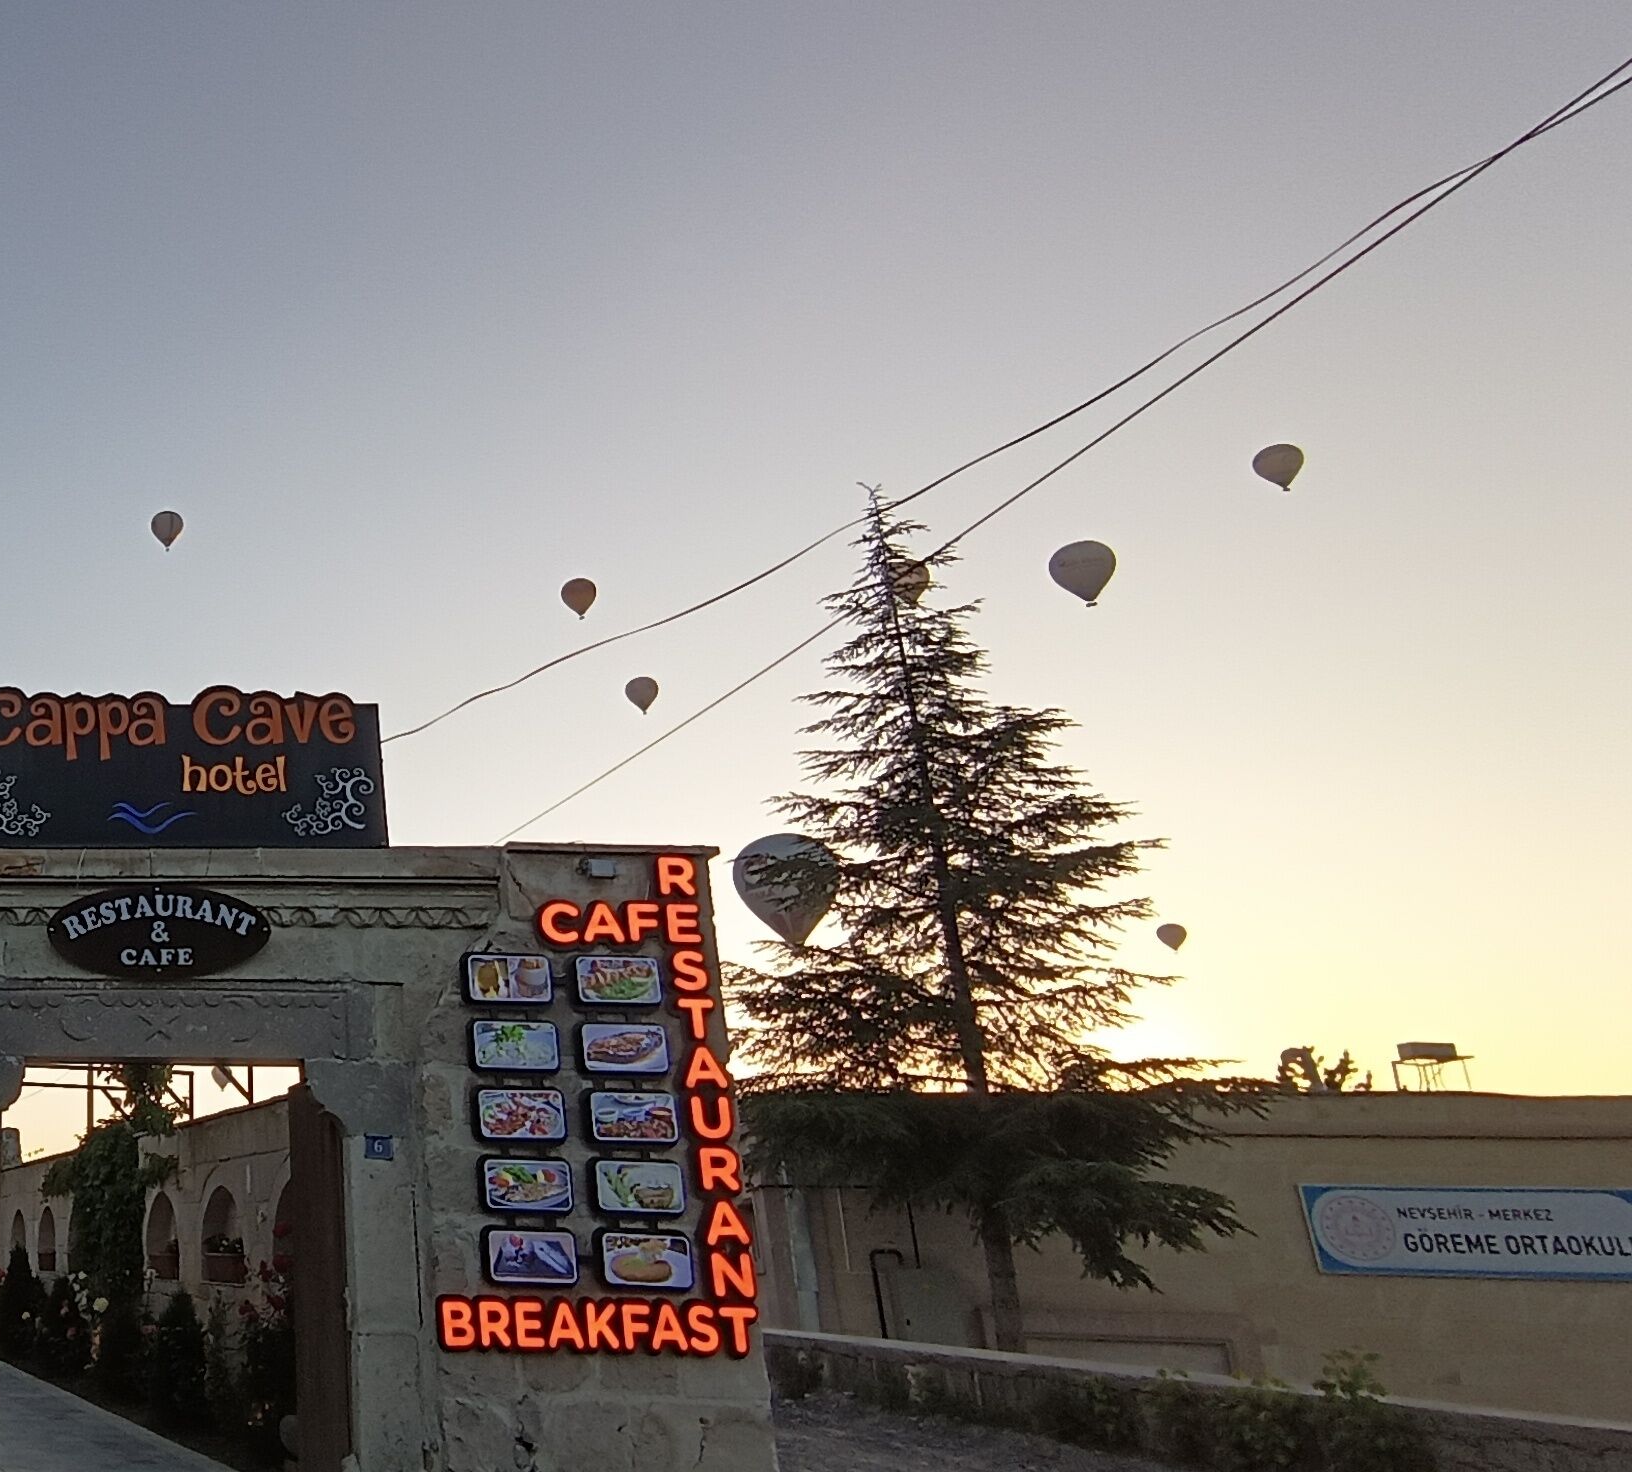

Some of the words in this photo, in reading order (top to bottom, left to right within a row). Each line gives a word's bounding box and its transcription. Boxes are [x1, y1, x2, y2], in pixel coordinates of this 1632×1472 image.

[191, 690, 356, 746] Cave
[181, 753, 288, 795] hotel
[62, 894, 257, 942] RESTAURANT
[151, 921, 170, 943] &
[120, 947, 194, 967] CAFE
[374, 1139, 383, 1153] 6
[1396, 1205, 1474, 1222] NEVŞEHİR
[1487, 1208, 1554, 1223] MERKEZ
[1403, 1227, 1500, 1255] GÖREME
[1504, 1234, 1632, 1257] ORTAOKUL
[441, 1300, 757, 1354] BREAKFAST
